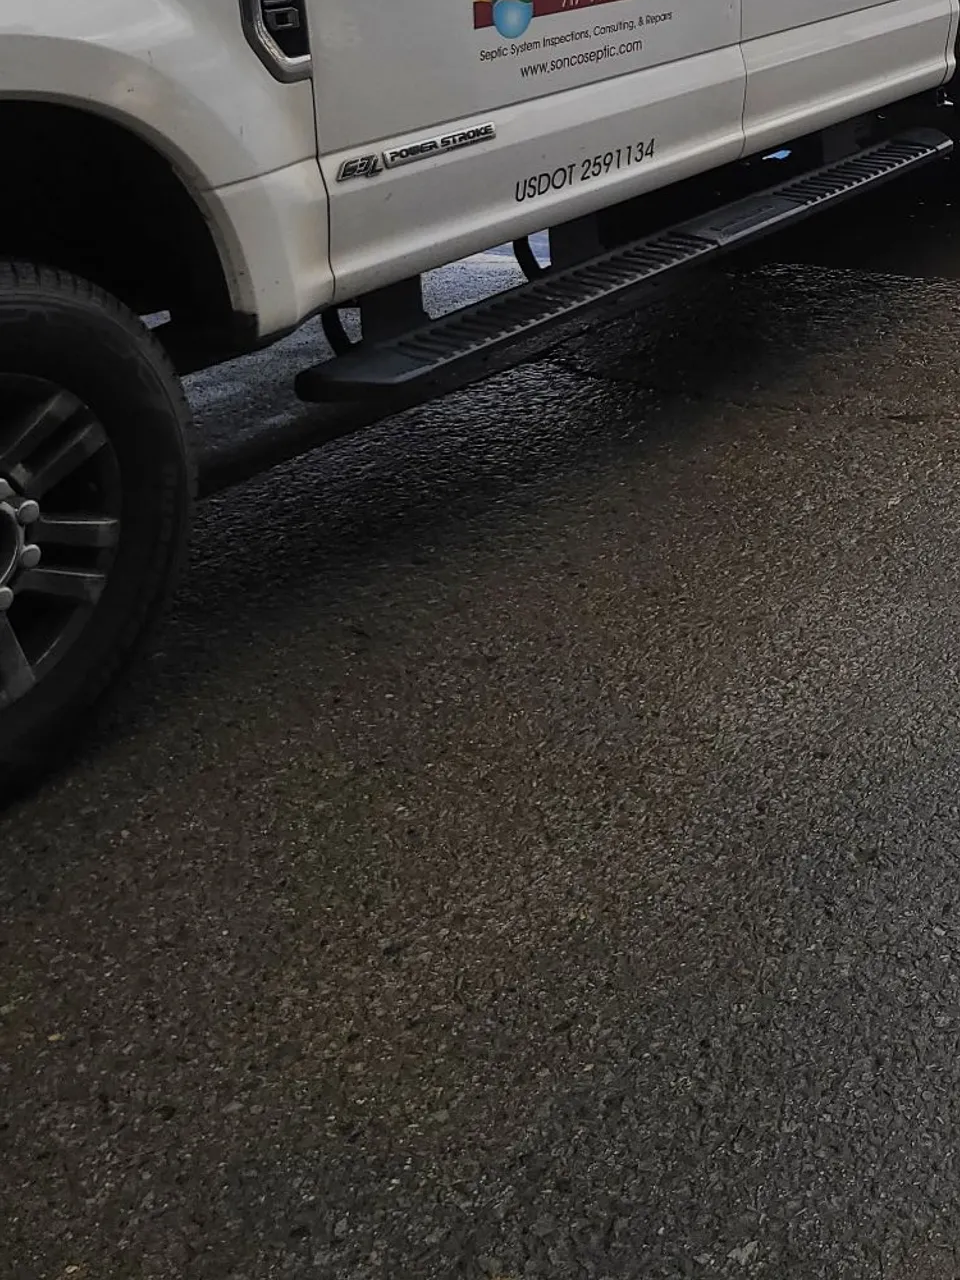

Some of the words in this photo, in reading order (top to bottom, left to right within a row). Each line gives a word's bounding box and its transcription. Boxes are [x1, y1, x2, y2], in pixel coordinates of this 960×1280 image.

[479, 46, 508, 62] Septic
[510, 40, 541, 56] System
[543, 28, 592, 48] Inspections,
[593, 19, 636, 37] Consulting,
[637, 16, 644, 26] &
[645, 11, 673, 26] Repairs
[520, 38, 643, 78] www.soncoseptic.com
[389, 140, 439, 162] POWER
[441, 124, 494, 147] STROKE
[515, 164, 577, 202] USDOT
[580, 138, 656, 181] 2591134
